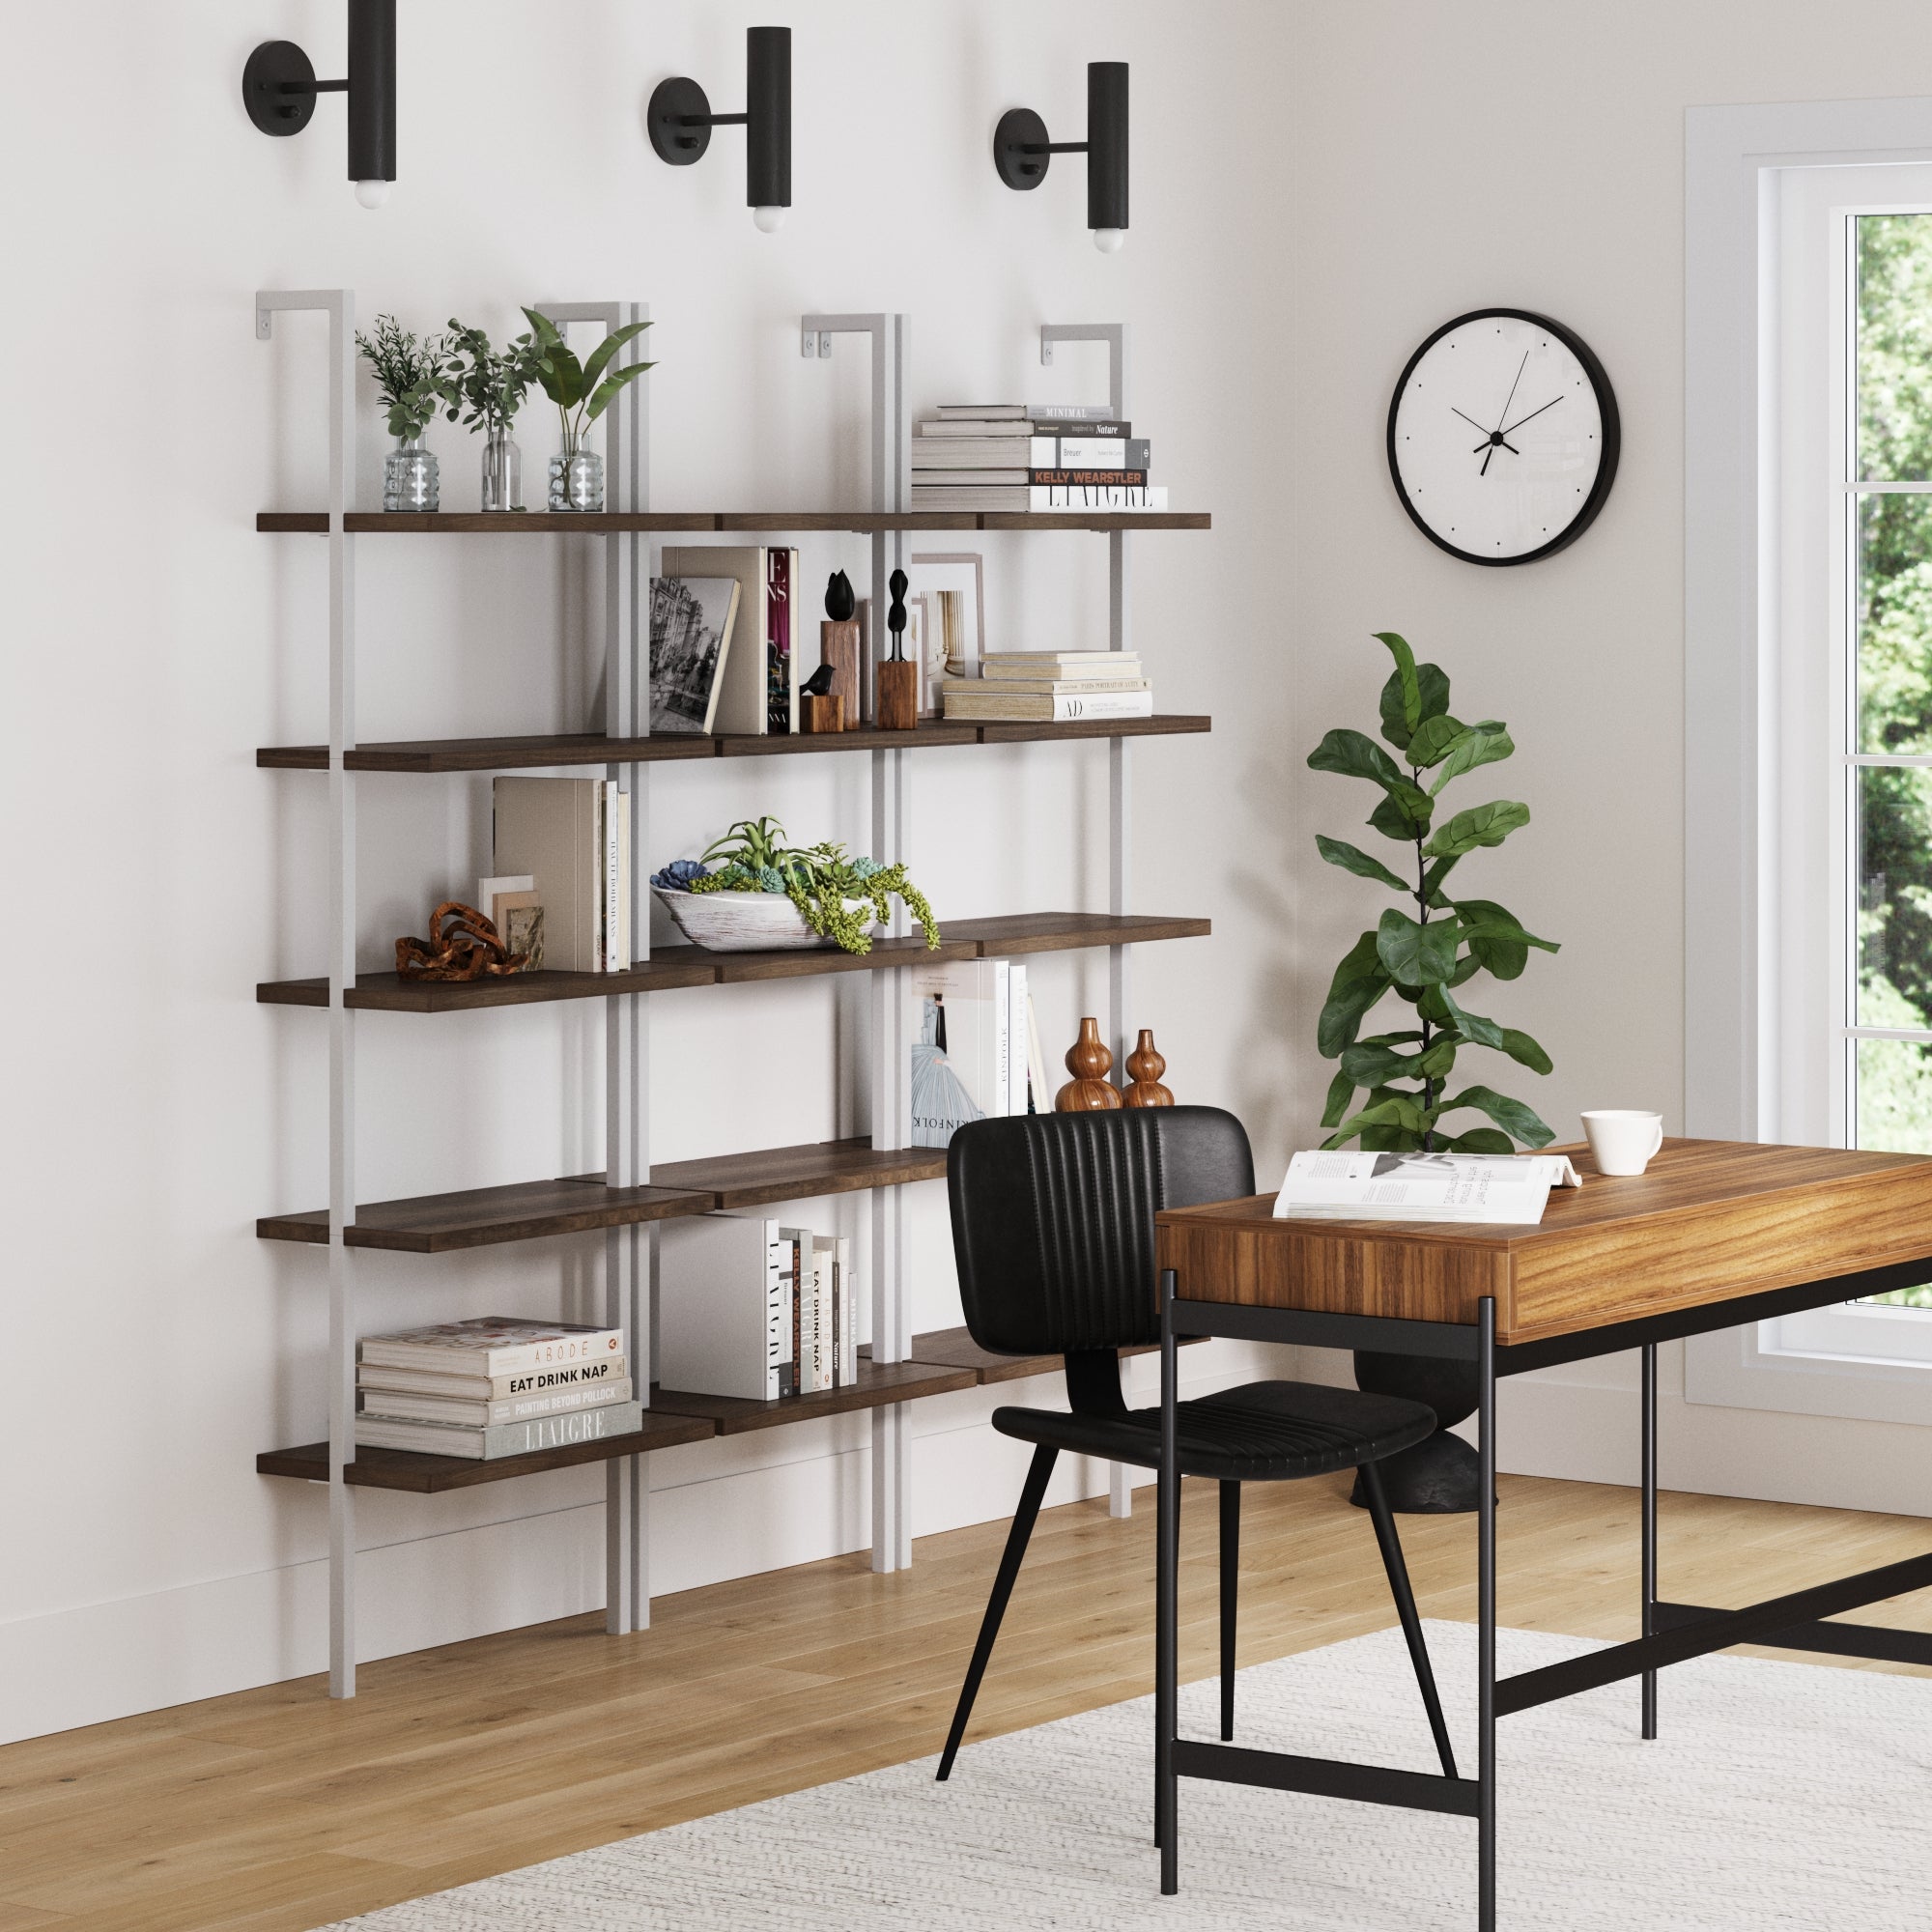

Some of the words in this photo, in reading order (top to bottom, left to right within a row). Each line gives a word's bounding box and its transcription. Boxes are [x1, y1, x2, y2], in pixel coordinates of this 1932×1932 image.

[1045, 407, 1087, 418] MINIMAL
[1095, 425, 1119, 435] Nature
[1063, 448, 1082, 457] Breuer
[1035, 471, 1070, 483] KELLY
[1073, 471, 1142, 483] WEARSTLER
[535, 1341, 588, 1363] ABODE
[510, 1378, 534, 1393] EAT
[537, 1369, 578, 1387] DRINK
[582, 1364, 609, 1380] NAP
[515, 1398, 550, 1415] PAINTING
[551, 1394, 581, 1409] BEYOND
[582, 1386, 616, 1404] POLLOCK
[525, 1410, 606, 1450] LIAIGRE
